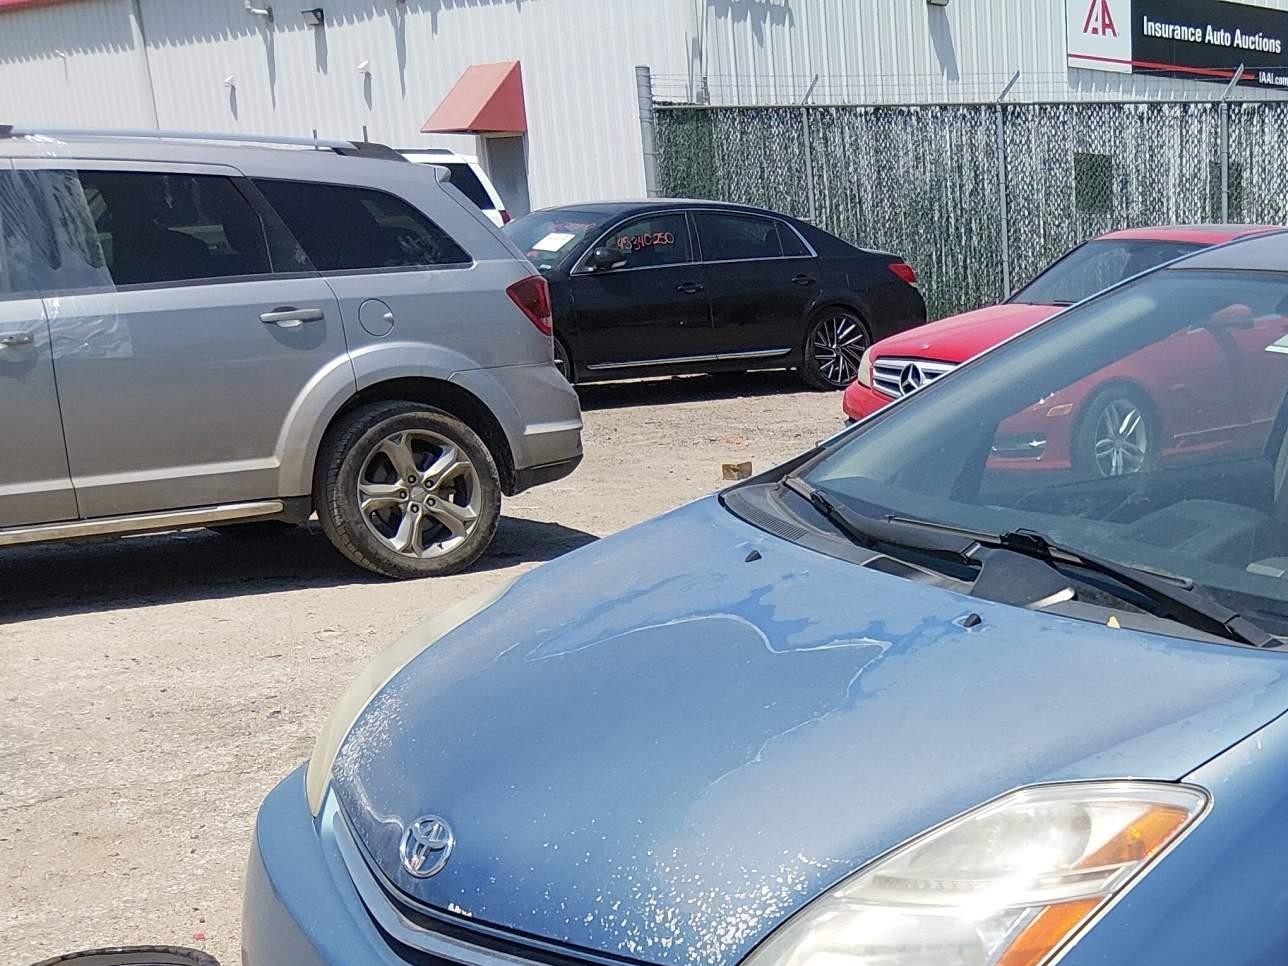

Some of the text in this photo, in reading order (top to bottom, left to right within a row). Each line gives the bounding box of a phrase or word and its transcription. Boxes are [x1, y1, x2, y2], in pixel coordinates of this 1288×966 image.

[1142, 15, 1282, 55] Insurance Auto Auctions
